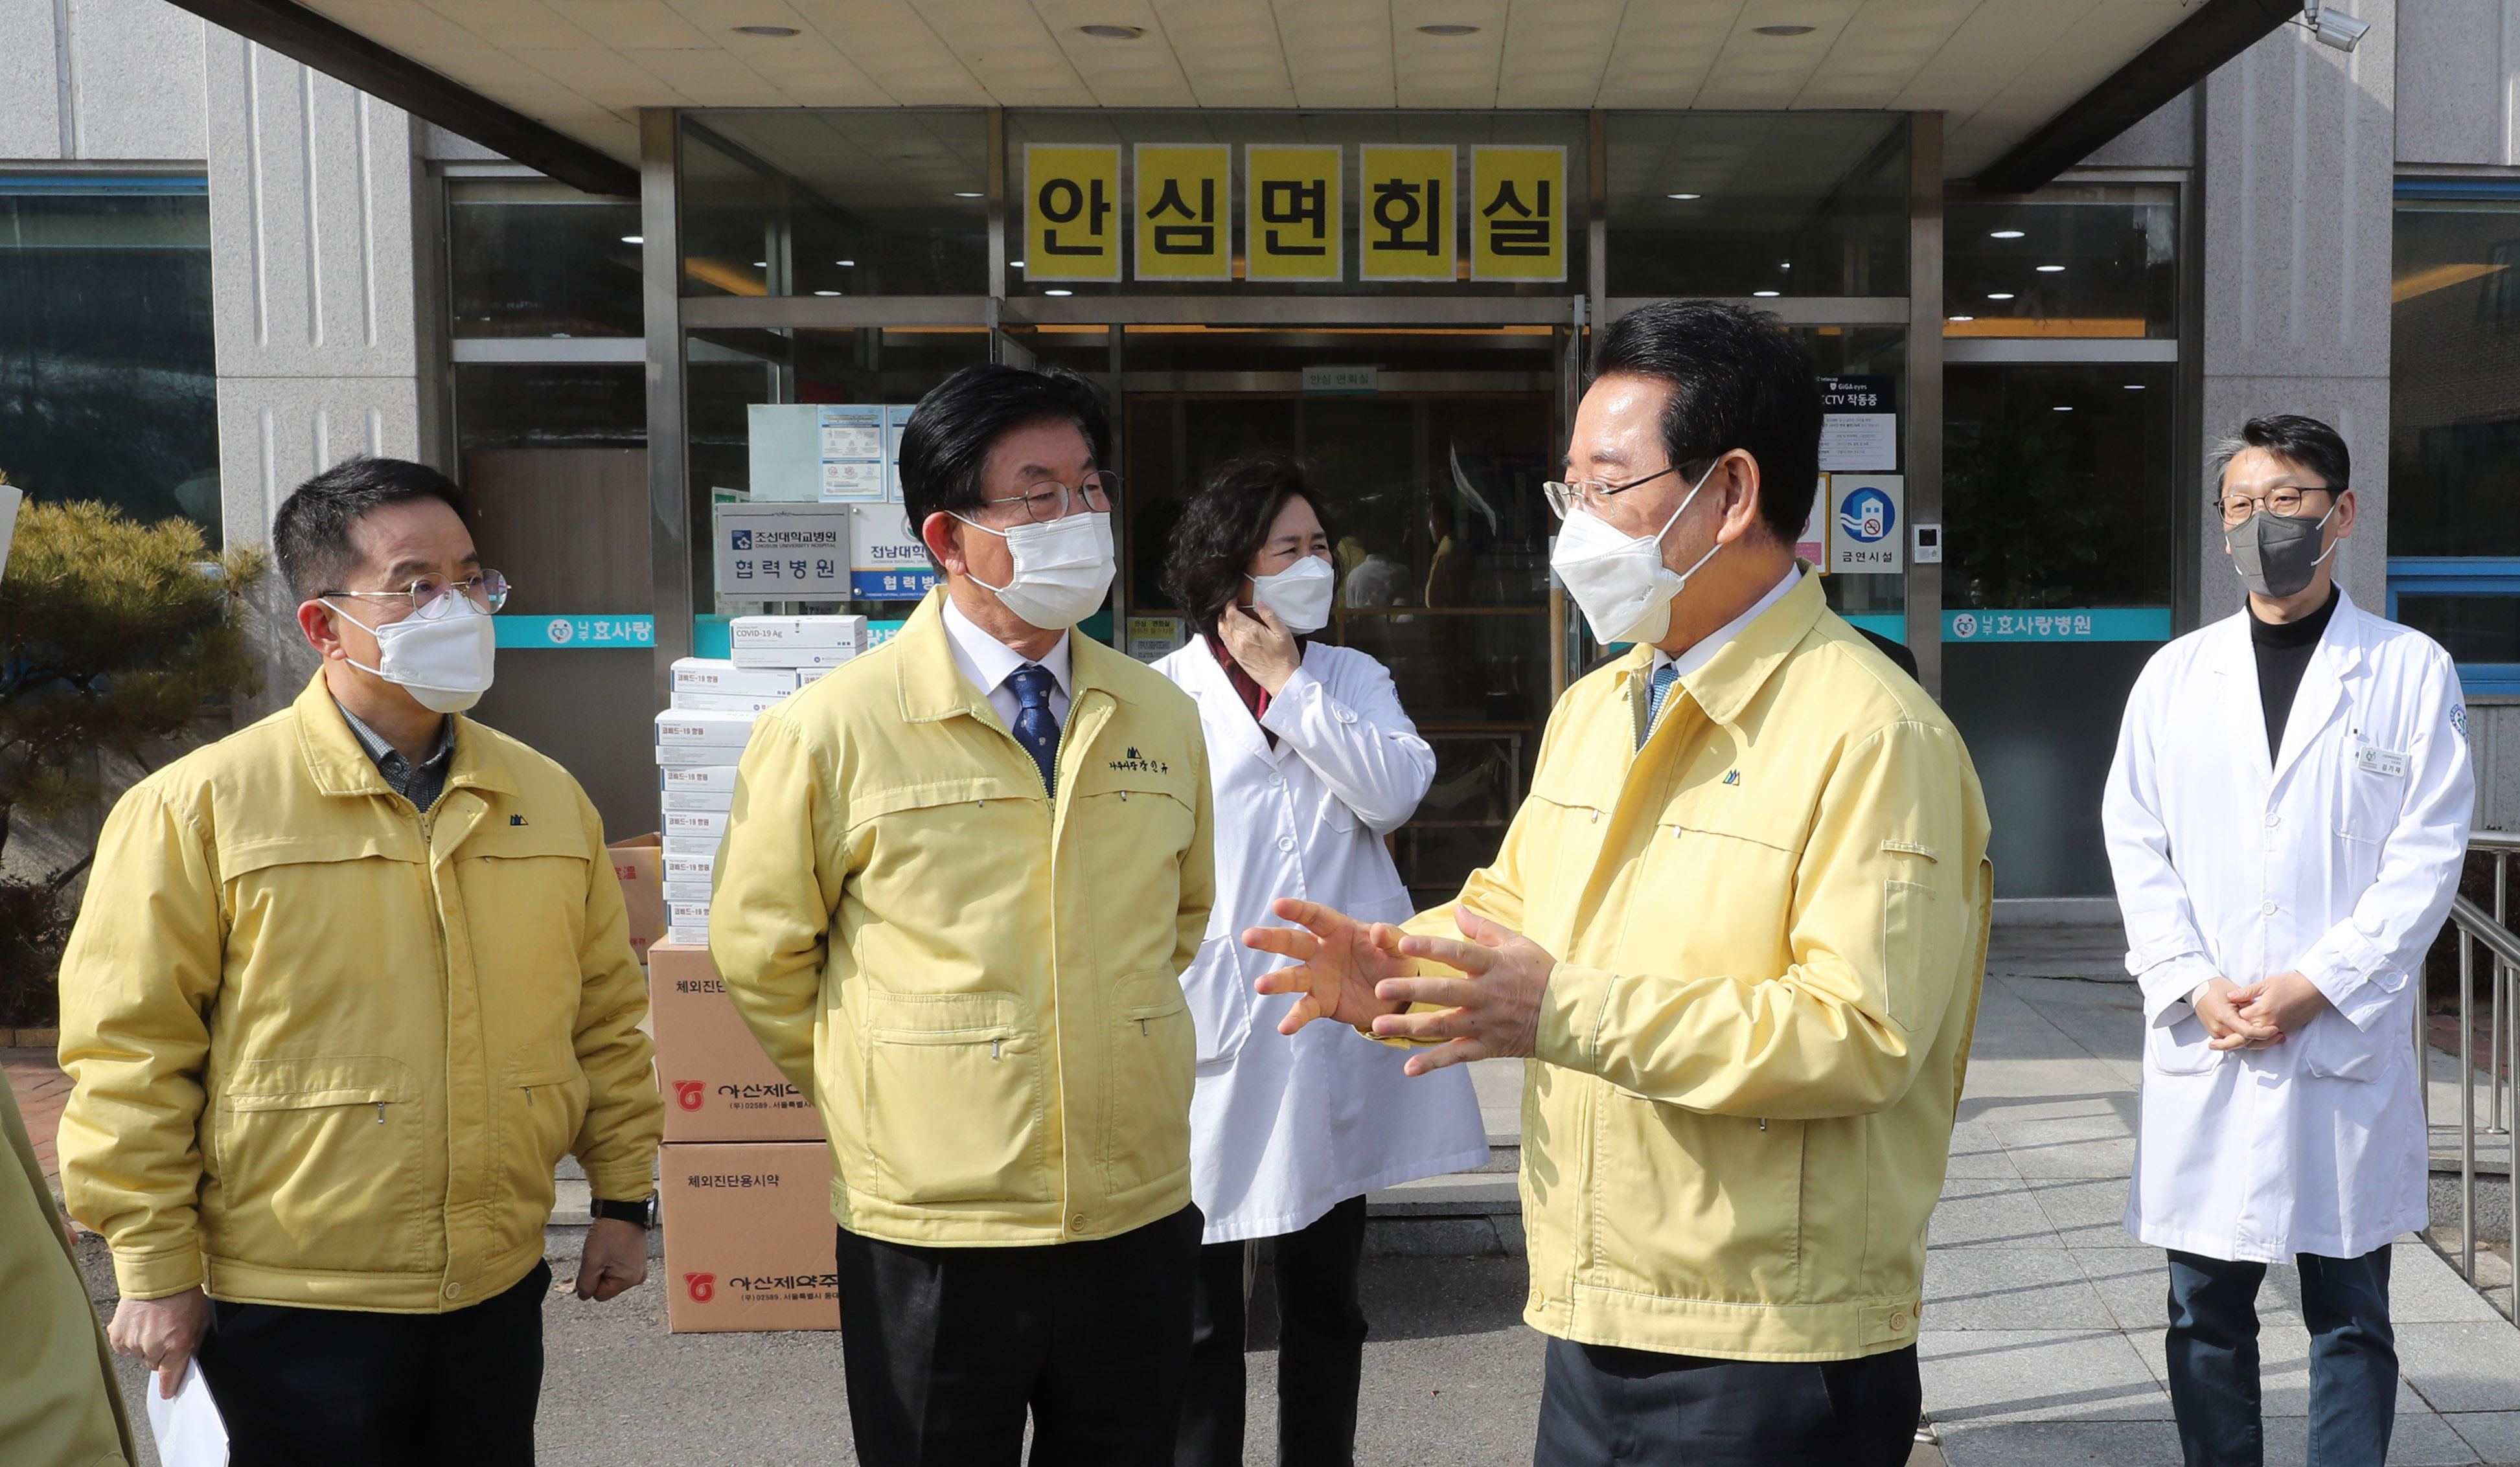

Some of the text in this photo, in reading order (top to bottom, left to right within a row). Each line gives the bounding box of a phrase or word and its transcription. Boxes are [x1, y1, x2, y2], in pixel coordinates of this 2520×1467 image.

[1038, 177, 1550, 256] 안심면회실
[1310, 374, 1369, 385] 안심 면회실
[1847, 394, 1877, 406] 작동중
[755, 531, 836, 543] 조선대학교병원
[1842, 551, 1892, 563] 금연시설
[735, 559, 834, 580] 협력병원
[593, 620, 652, 641] 효사랑
[1996, 615, 2092, 636] 효사랑병원
[772, 630, 783, 639] Ag
[687, 1174, 780, 1188] 체외진단용시약
